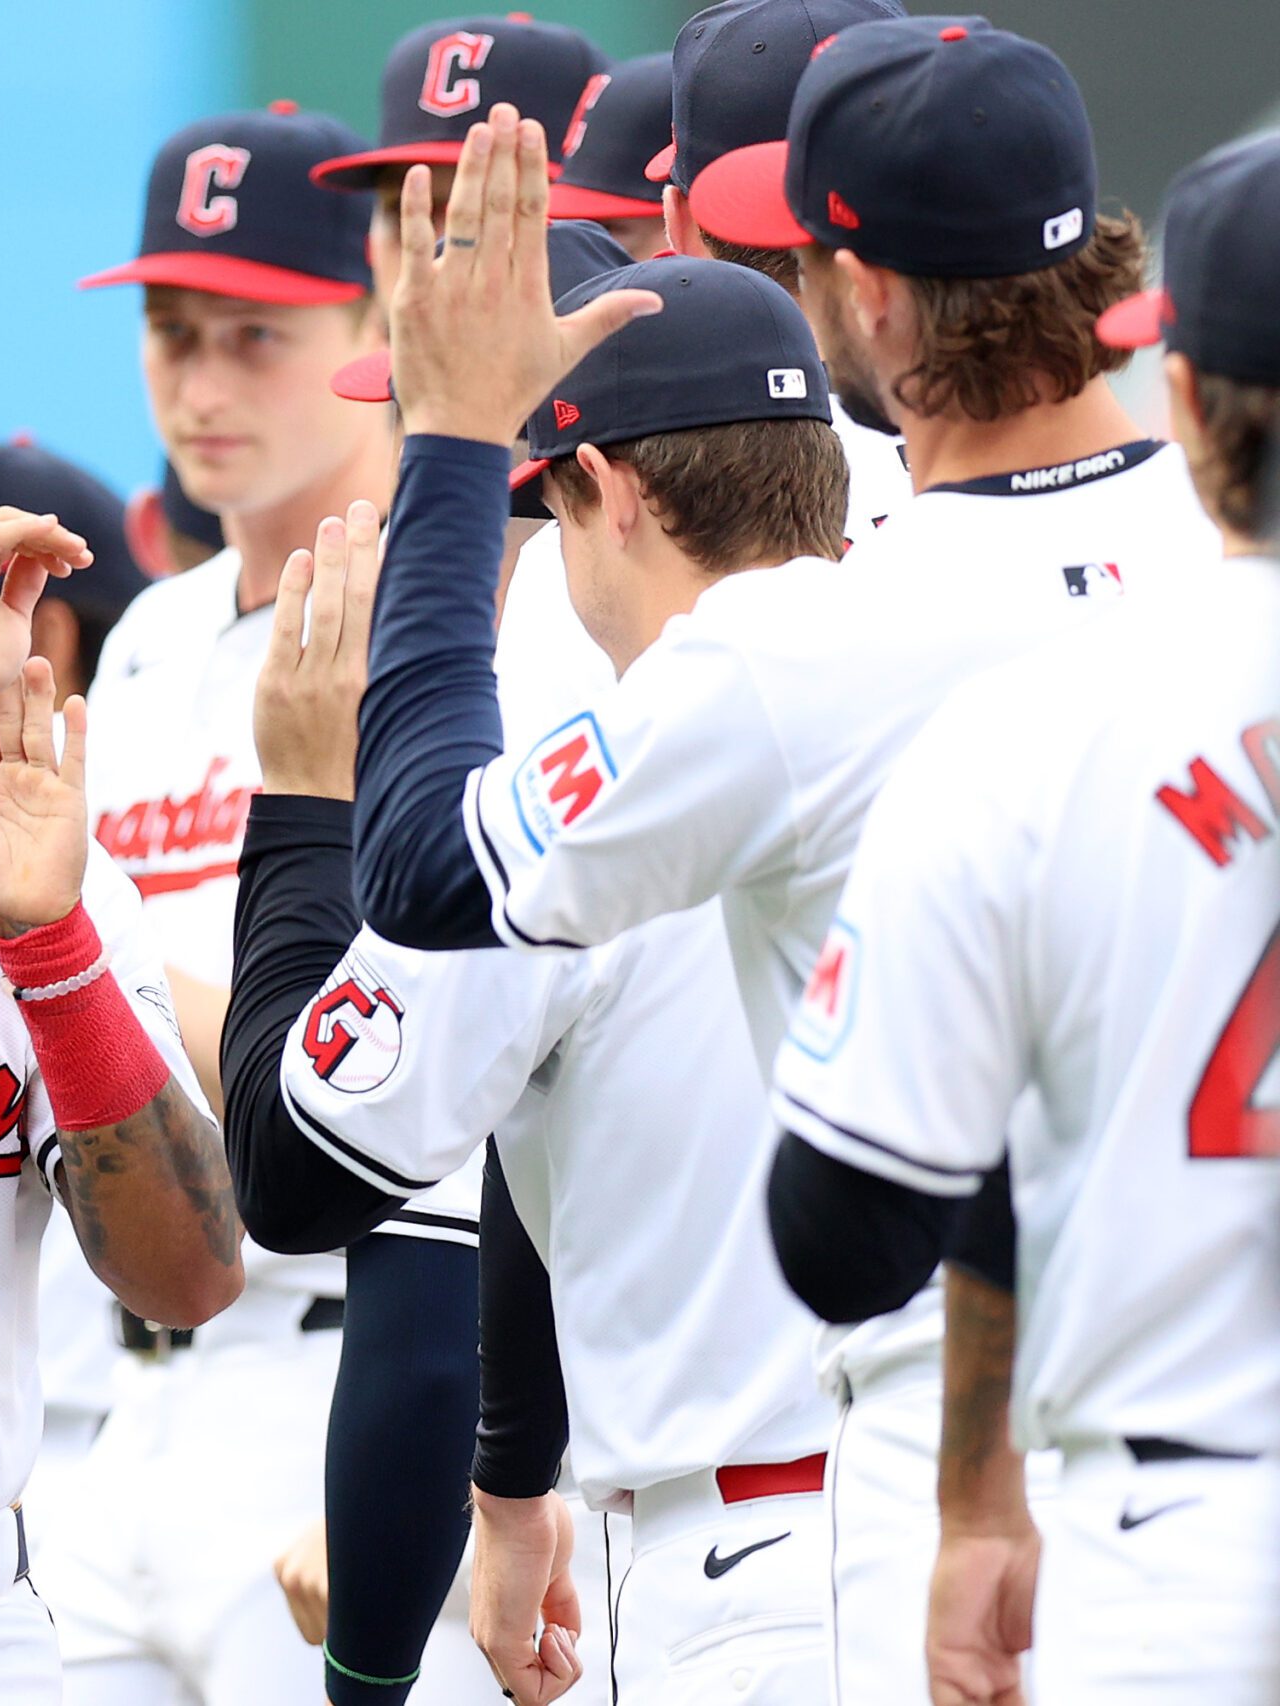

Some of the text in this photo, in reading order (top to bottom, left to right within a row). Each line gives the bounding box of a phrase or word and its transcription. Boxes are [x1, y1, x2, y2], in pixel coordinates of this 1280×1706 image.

[419, 31, 494, 118] C
[176, 143, 252, 238] C
[1010, 463, 1074, 491] NIKE
[540, 733, 603, 827] M
